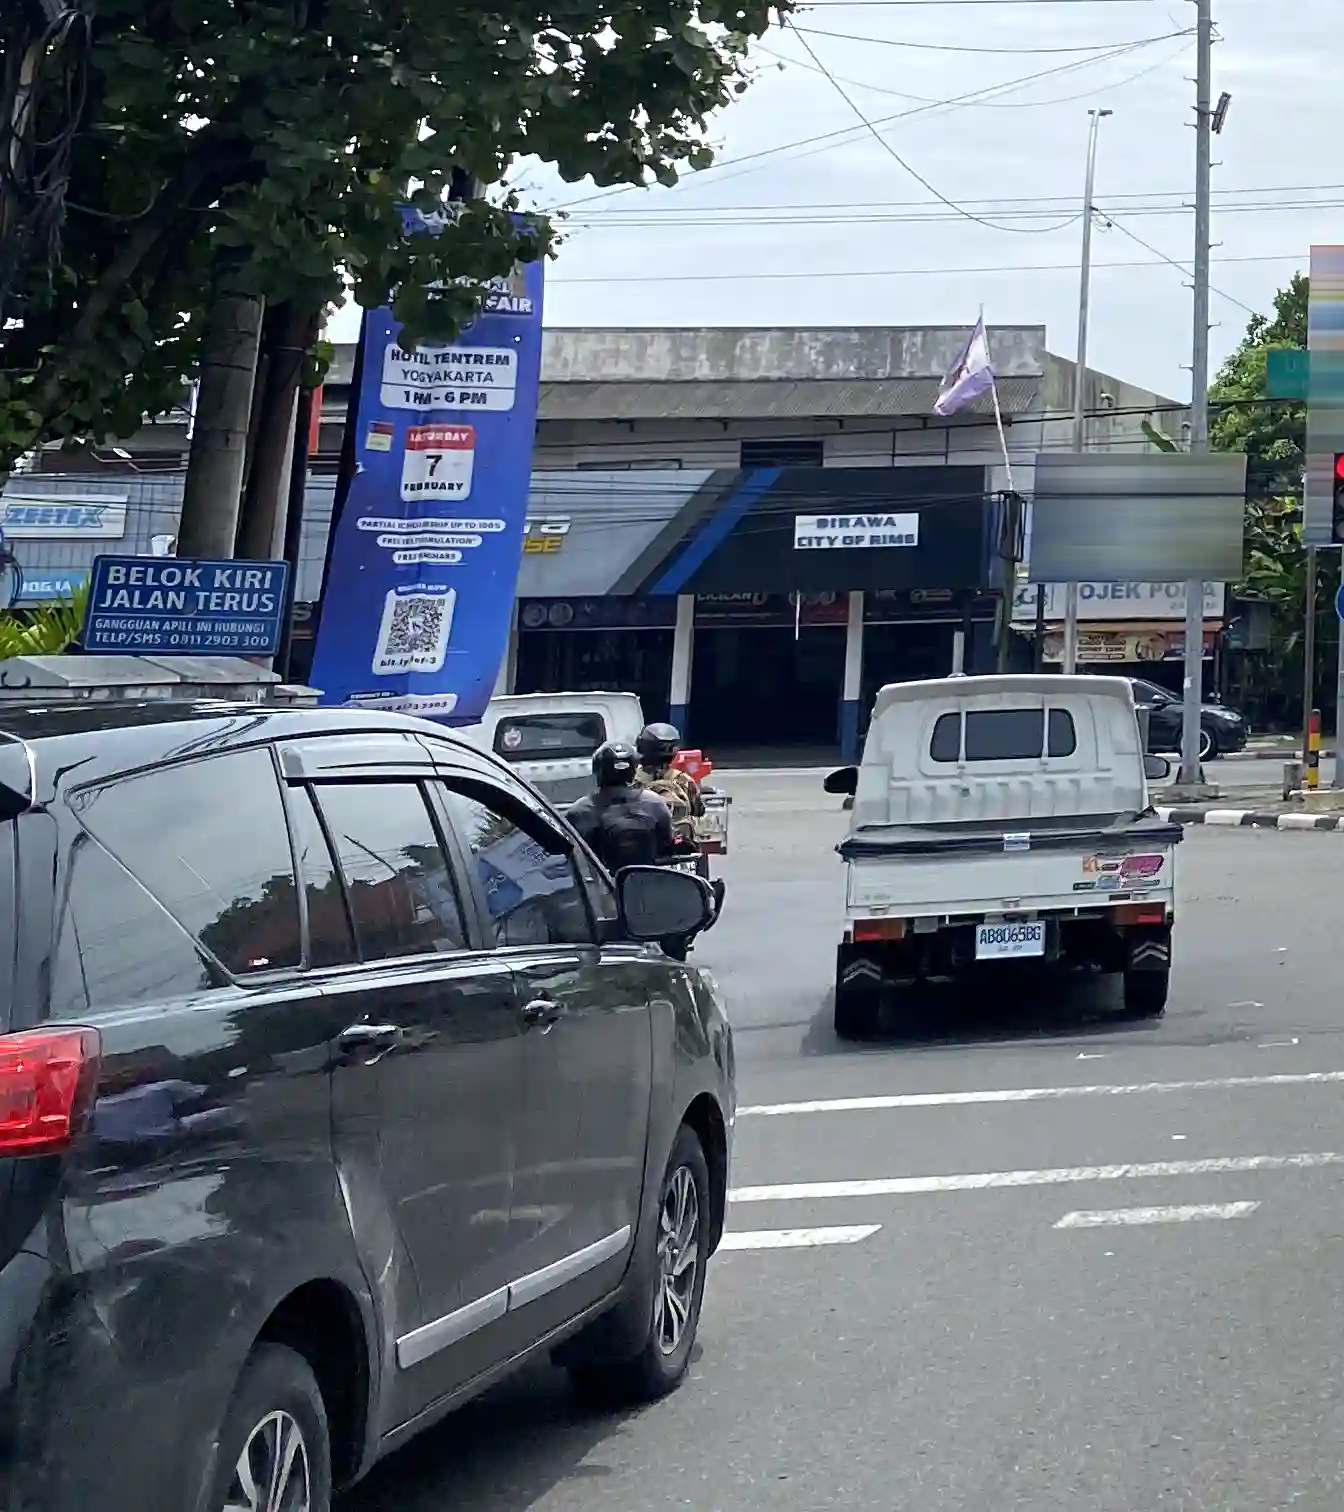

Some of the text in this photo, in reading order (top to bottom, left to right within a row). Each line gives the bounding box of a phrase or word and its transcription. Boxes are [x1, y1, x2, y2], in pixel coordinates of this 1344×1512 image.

[485, 296, 533, 313] FAIR
[434, 352, 510, 366] TENTREM
[402, 368, 494, 383] YOGYAKARTA
[403, 391, 411, 403] 1
[459, 392, 487, 405] PM
[425, 454, 443, 477] 7
[404, 482, 464, 491] FEBRUARY
[797, 535, 839, 547] CITY
[842, 535, 865, 545] OF
[107, 565, 272, 589] BELOK KIRI
[1080, 583, 1217, 600] OJEK POA
[99, 589, 185, 610] JALAN
[195, 591, 275, 613] TERUS
[95, 618, 160, 630] GANGGUAN
[196, 622, 212, 632] INI
[214, 622, 265, 633] HUBUNGI
[95, 632, 161, 645] TELP/SMS
[204, 635, 239, 646] 2903
[243, 636, 269, 647] 300
